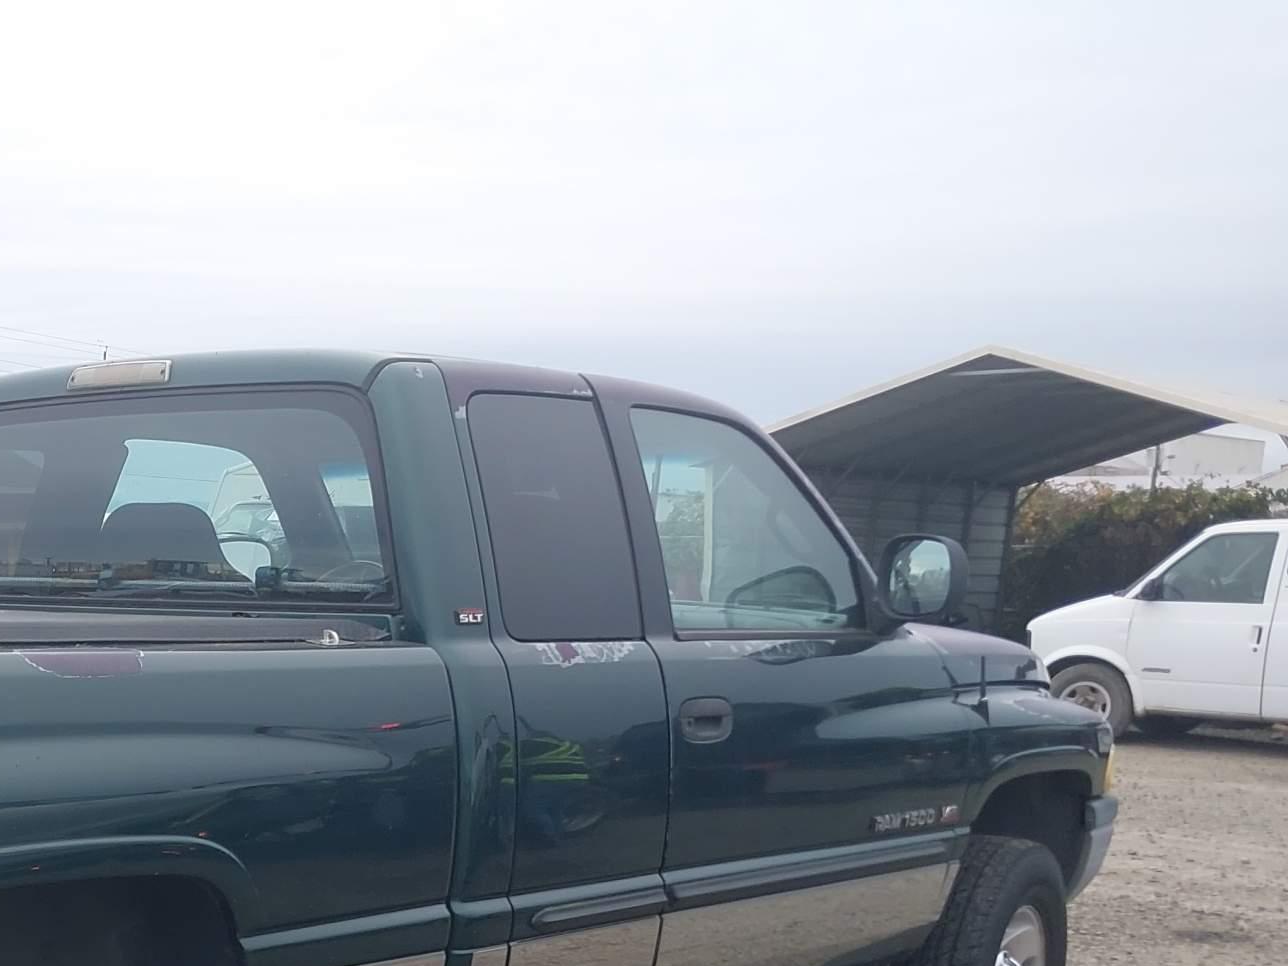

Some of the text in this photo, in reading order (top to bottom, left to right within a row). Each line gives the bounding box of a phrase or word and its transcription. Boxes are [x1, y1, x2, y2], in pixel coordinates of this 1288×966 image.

[459, 613, 484, 623] SLT
[873, 813, 903, 833] RAM
[903, 807, 936, 829] 1500
